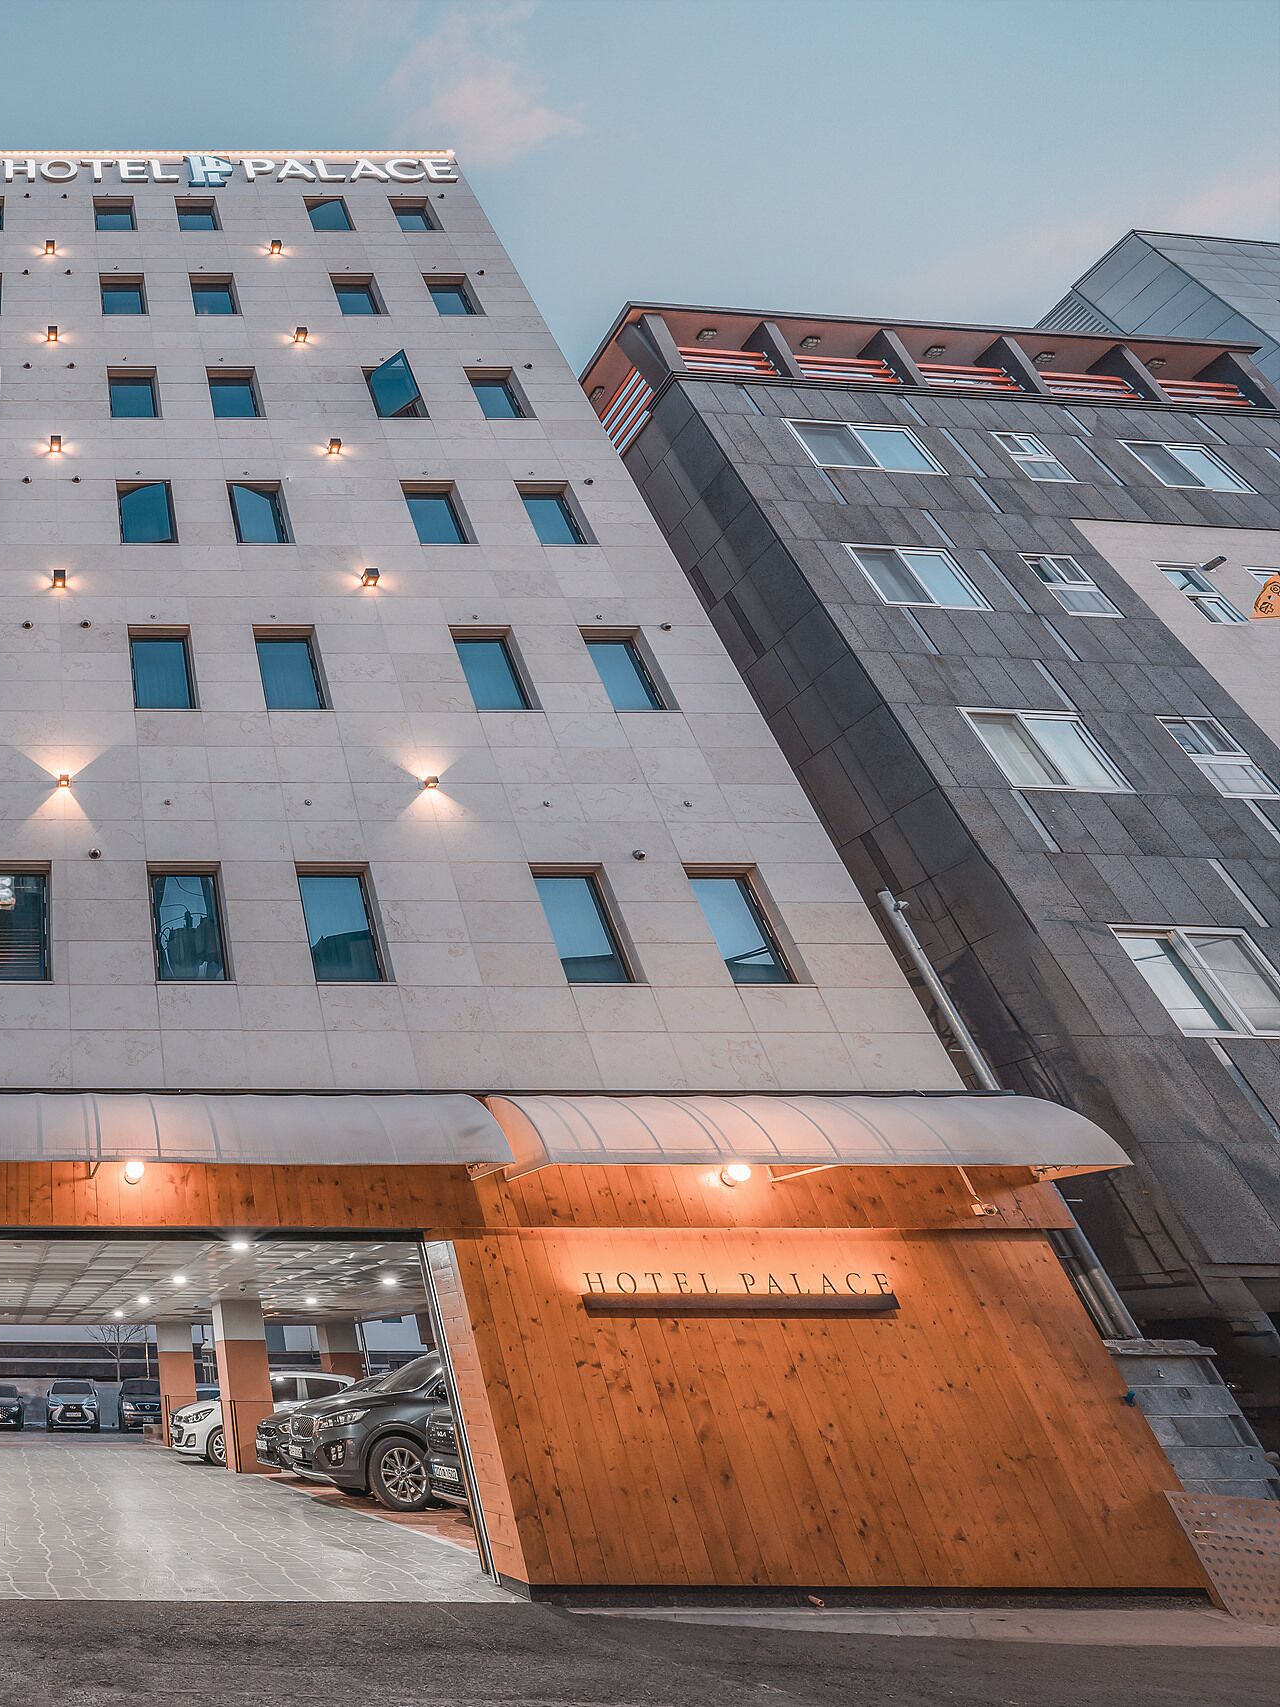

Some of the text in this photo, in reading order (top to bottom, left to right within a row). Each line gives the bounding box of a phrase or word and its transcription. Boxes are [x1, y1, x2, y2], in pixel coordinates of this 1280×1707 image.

[1, 158, 180, 183] HOTEL
[240, 158, 460, 183] PALACE
[582, 1272, 895, 1295] HOTEL PALACE
